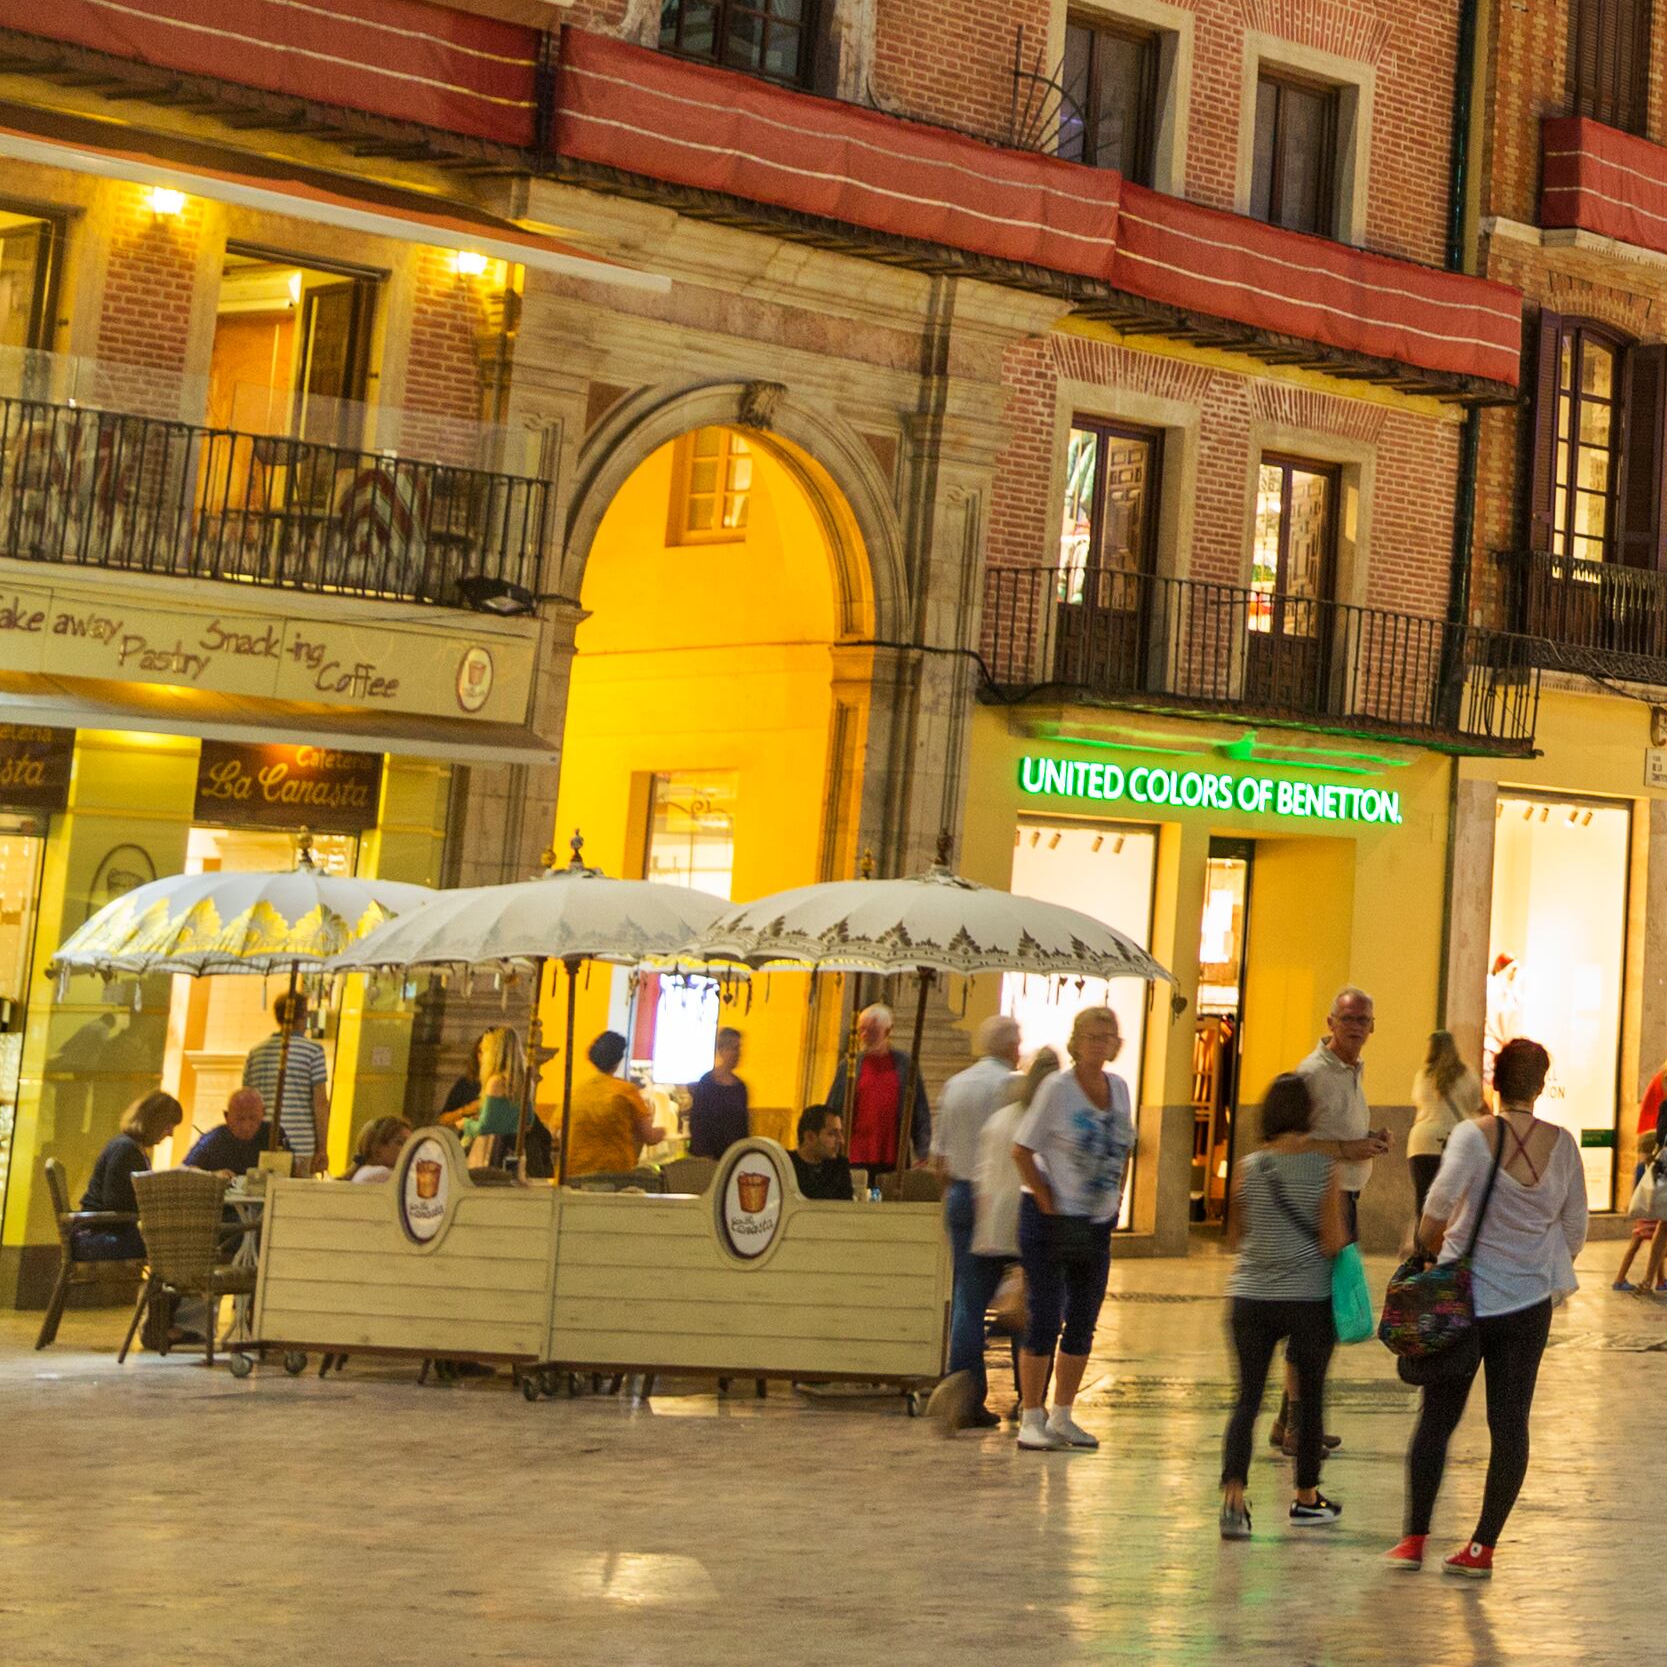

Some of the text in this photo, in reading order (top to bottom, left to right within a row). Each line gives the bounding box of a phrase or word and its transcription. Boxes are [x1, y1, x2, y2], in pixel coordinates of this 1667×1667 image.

[0, 593, 125, 646] ake away
[117, 634, 211, 680] Pastry
[313, 660, 401, 700] Coffee
[200, 760, 370, 809] La Canasta
[1018, 755, 1127, 802] UNITED
[1127, 766, 1235, 811] COLORS
[1236, 776, 1275, 814] OF
